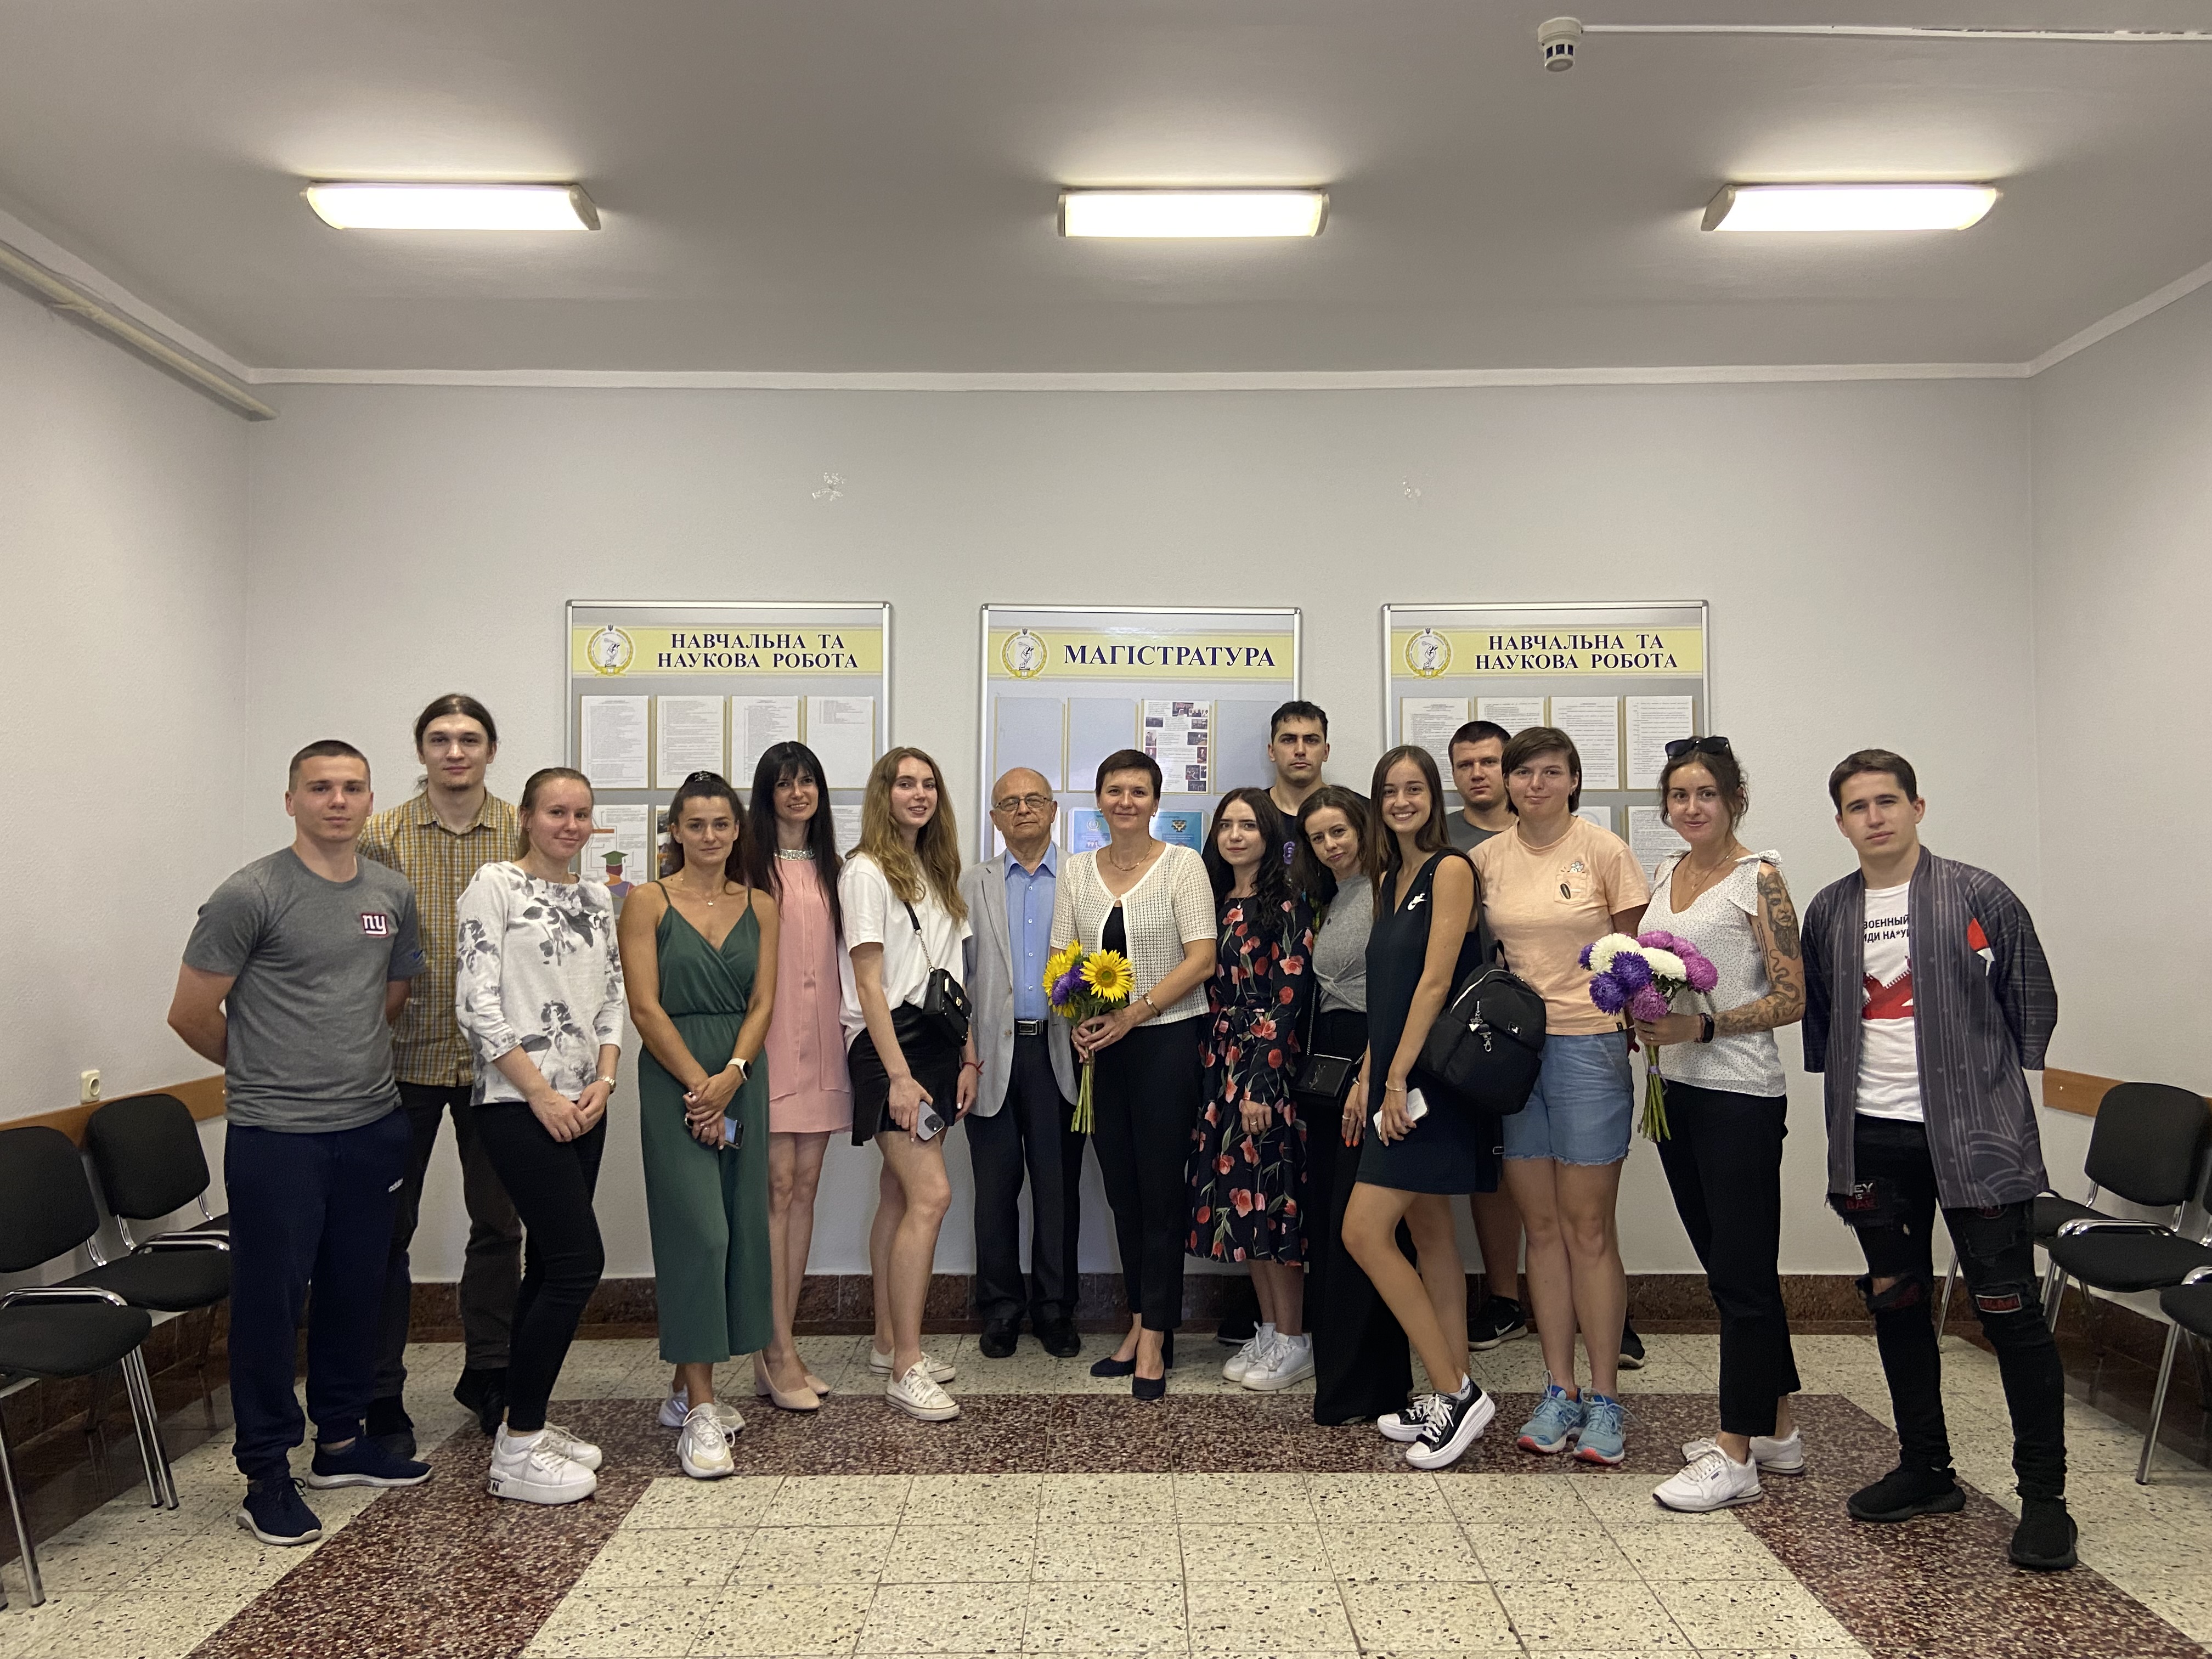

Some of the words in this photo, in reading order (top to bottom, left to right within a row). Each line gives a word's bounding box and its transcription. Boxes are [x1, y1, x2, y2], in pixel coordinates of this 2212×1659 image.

[672, 634, 806, 648] НАВЧАЛЬНА
[817, 634, 844, 649] ТА
[1489, 635, 1624, 650] НАВЧАЛЬНА
[1636, 634, 1664, 649] ТА
[658, 653, 760, 668] НАУКОВА
[773, 653, 857, 668] РОБОТА
[1064, 645, 1276, 667] МАГІСТРАТУРА
[1476, 654, 1579, 669] НАУКОВА
[1592, 653, 1678, 669] РОБОТА
[1864, 914, 1909, 929] ВОЕННЫЙ
